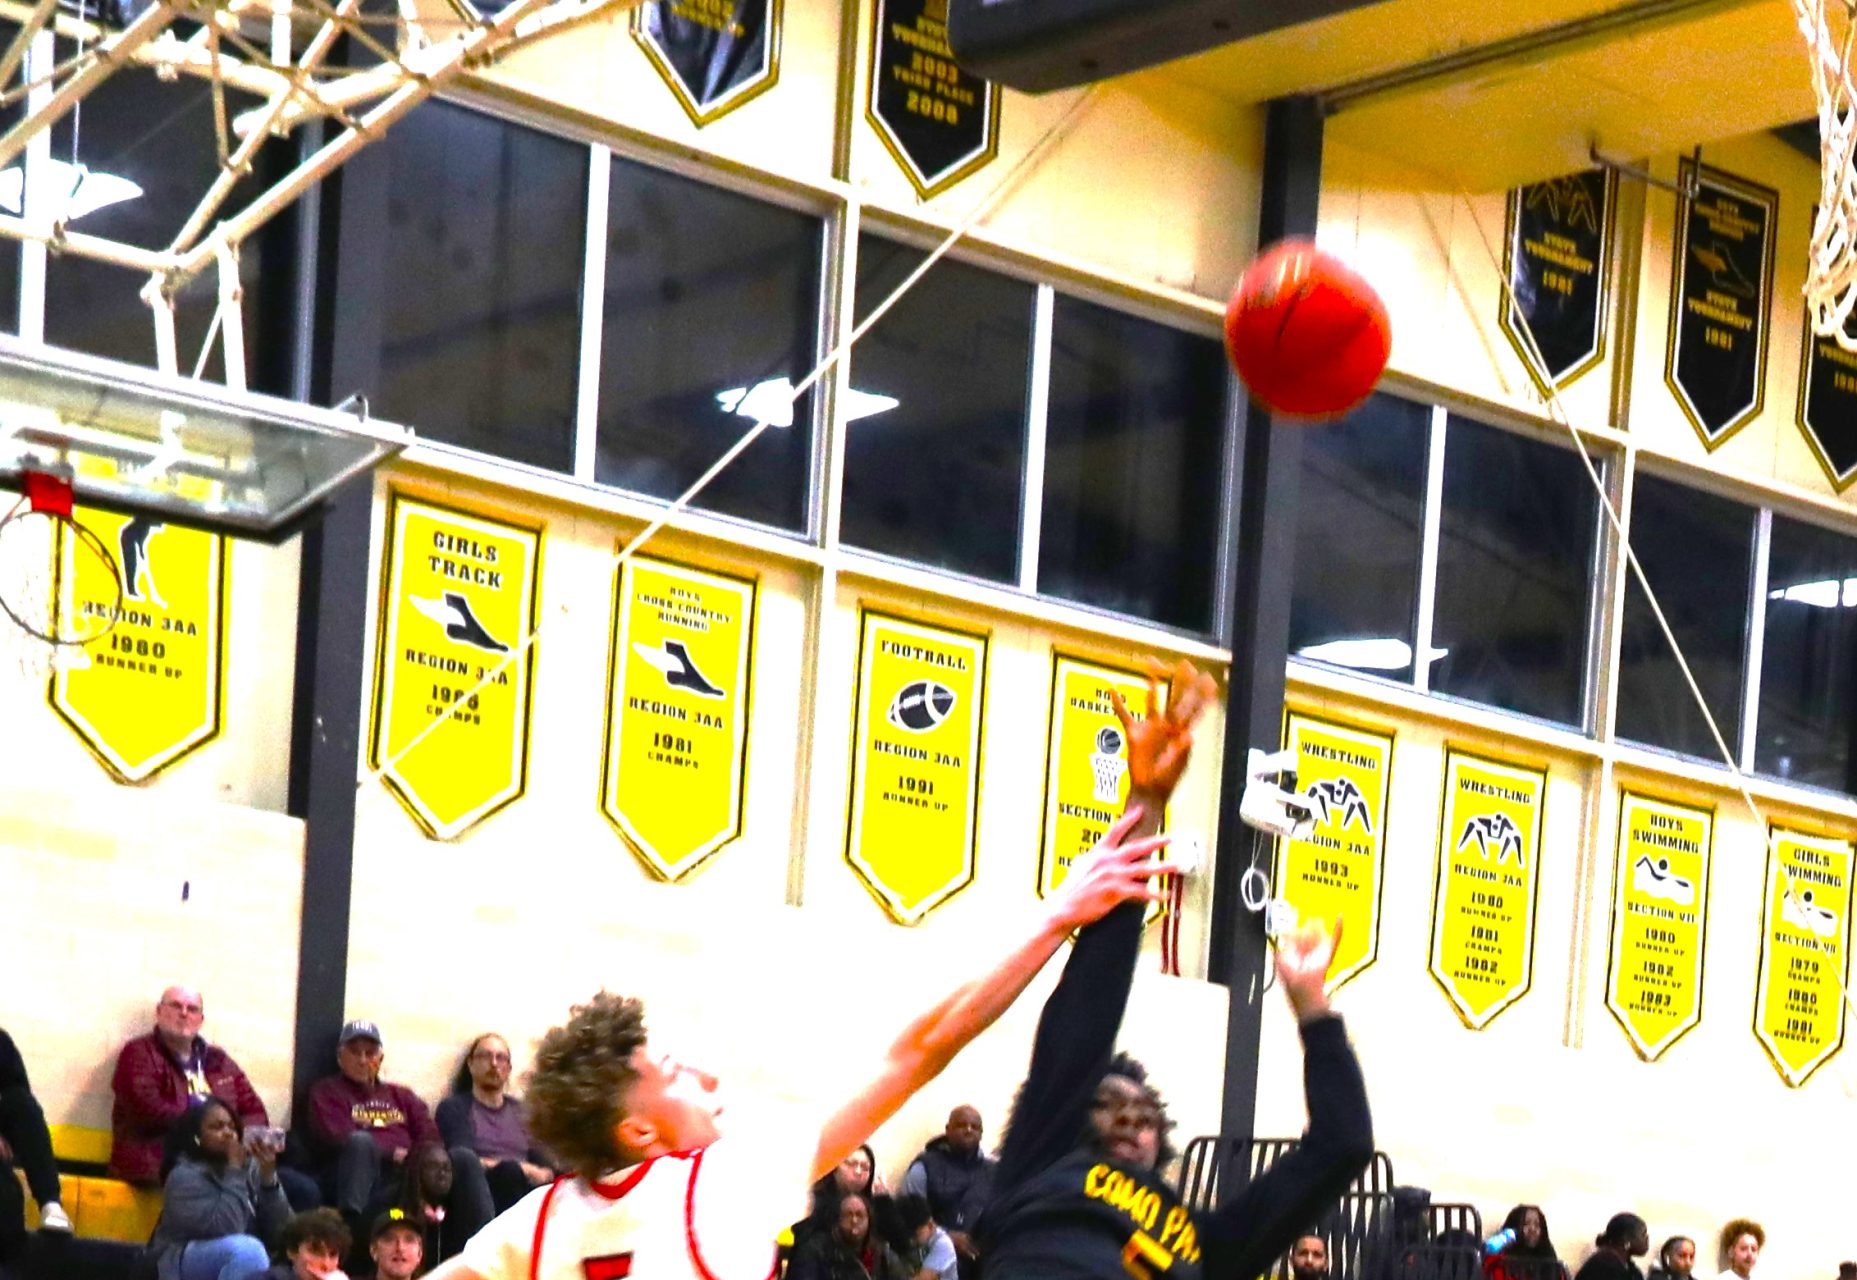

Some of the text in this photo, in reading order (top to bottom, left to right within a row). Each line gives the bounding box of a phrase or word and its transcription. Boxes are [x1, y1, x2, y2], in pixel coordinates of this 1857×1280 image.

[434, 530, 496, 561] GIRLS
[429, 555, 500, 588] TRACK
[162, 617, 196, 638] 3AA
[112, 632, 165, 659] 1980
[882, 640, 966, 671] FOOTBALL
[96, 653, 182, 679] RUNNER UP
[406, 649, 508, 686] REGION 3A
[426, 704, 480, 726] CHMPS
[630, 697, 722, 729] REGION 3AA
[654, 732, 692, 754] 1981
[874, 739, 961, 768] REGION 3AA
[1302, 741, 1376, 770] WRESTLING
[648, 751, 699, 770] CHAMPS
[883, 792, 949, 813] RUNNER UP
[1460, 778, 1530, 804] WRESTLING
[1059, 802, 1112, 824] SECTION
[1651, 814, 1683, 832] BOYS
[1633, 828, 1699, 854] SWIMMING
[1794, 848, 1830, 867] GIRLS
[1455, 863, 1497, 881] REGION
[1784, 862, 1842, 887] WIMMING
[1347, 882, 1360, 892] UP
[1628, 901, 1674, 919] SECTION
[1084, 1163, 1162, 1230] COMO
